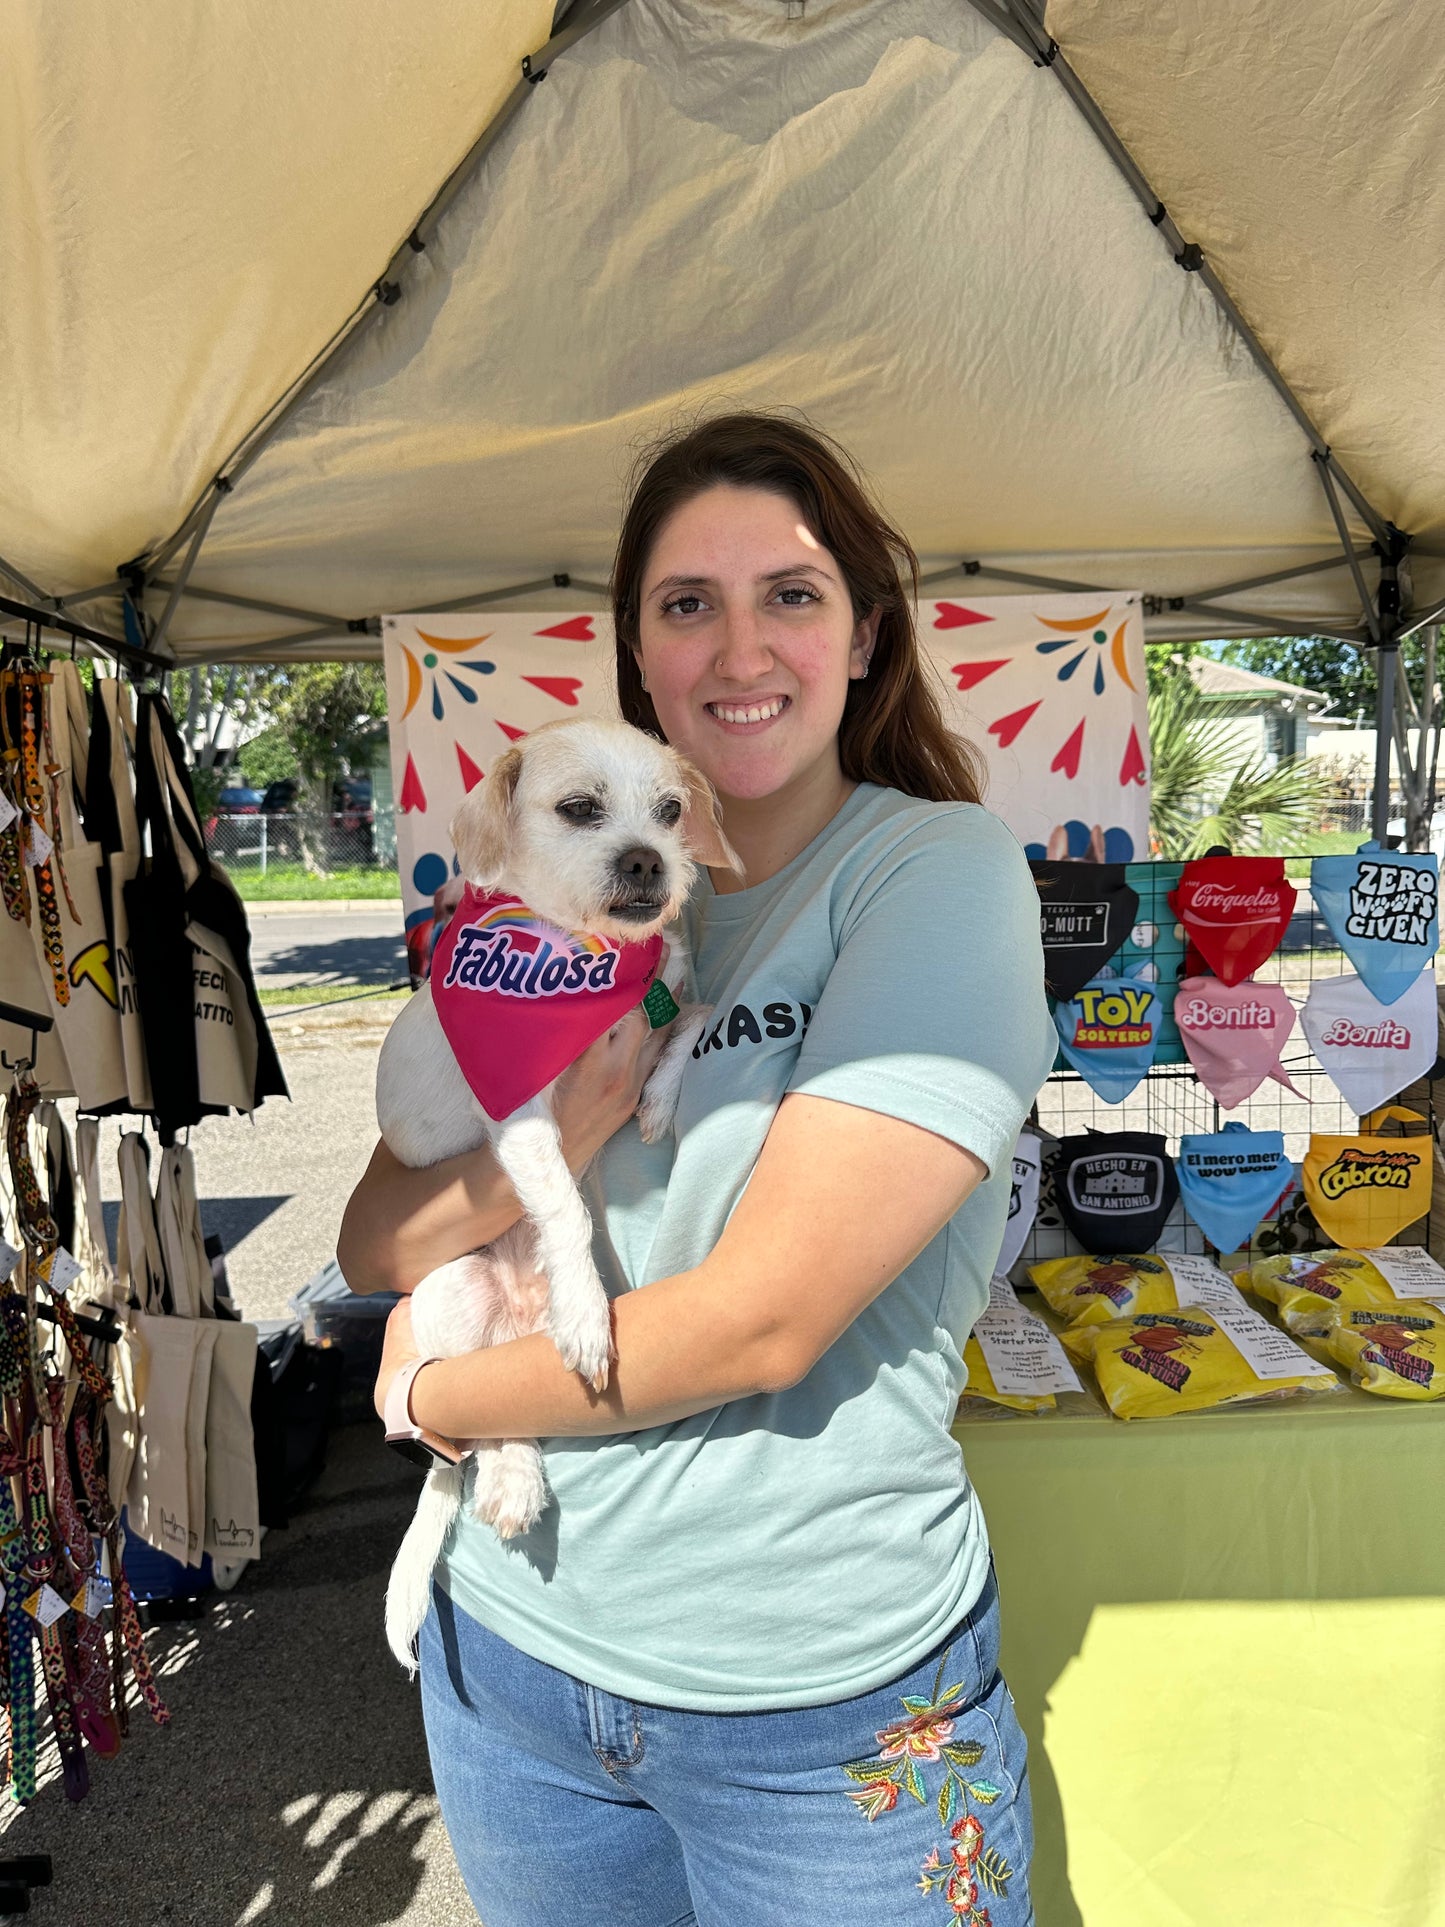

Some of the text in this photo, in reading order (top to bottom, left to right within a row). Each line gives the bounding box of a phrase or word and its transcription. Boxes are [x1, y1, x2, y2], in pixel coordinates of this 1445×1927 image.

[1357, 863, 1435, 896] ZERO
[1047, 906, 1075, 914] TEXAS
[1191, 883, 1280, 913] Croquetas
[1347, 914, 1427, 944] GIVEN
[446, 927, 617, 995] Fabulosa
[195, 1002, 234, 1026] ATITO
[1073, 987, 1153, 1027] TOY
[1182, 999, 1274, 1029] Bonita
[1076, 1029, 1151, 1042] SOLTERO
[1322, 1018, 1410, 1048] Bonita
[1015, 1163, 1028, 1177] EN
[1085, 1159, 1148, 1174] HECHO EN
[1187, 1152, 1280, 1165] El mero mer
[1197, 1164, 1278, 1177] wow wow
[1320, 1162, 1409, 1198] Cabron
[1080, 1194, 1151, 1209] SAN ANTONIO
[990, 1336, 1025, 1345] Starter
[1141, 1347, 1188, 1378] CHICKEN
[1381, 1345, 1430, 1372] CHICKEN
[1394, 1361, 1428, 1383] STICK
[1149, 1361, 1182, 1389] STICK
